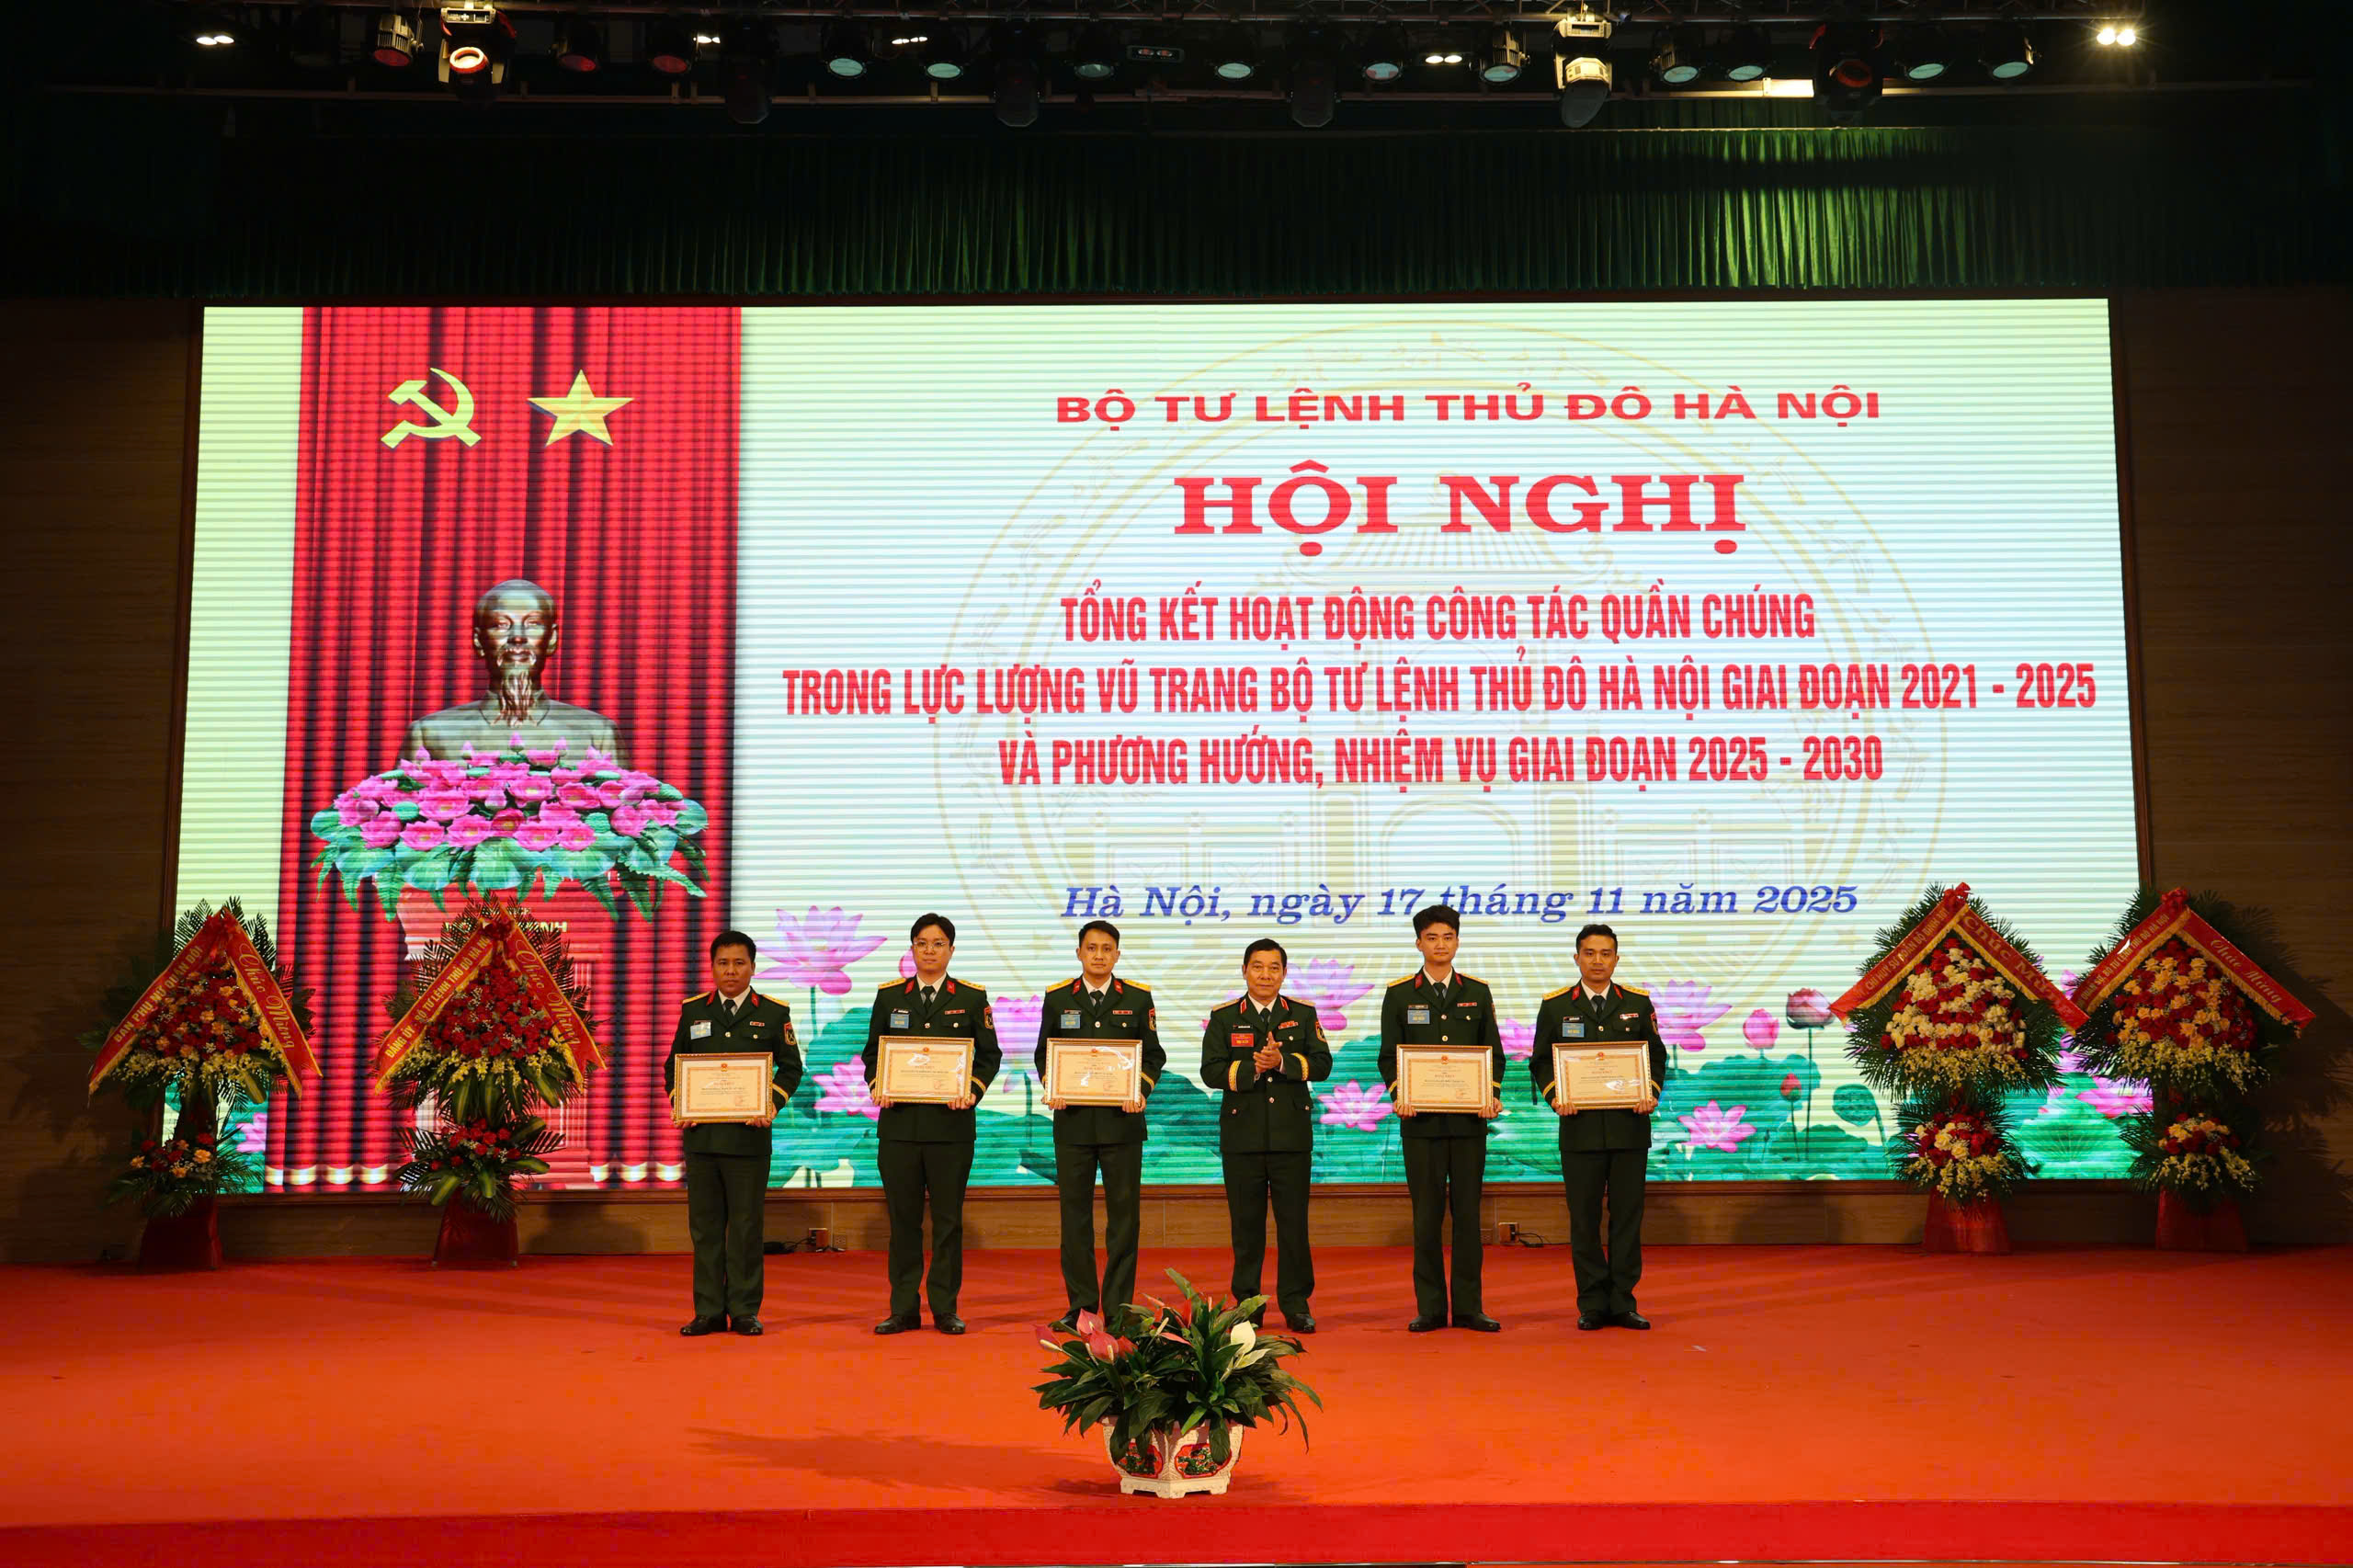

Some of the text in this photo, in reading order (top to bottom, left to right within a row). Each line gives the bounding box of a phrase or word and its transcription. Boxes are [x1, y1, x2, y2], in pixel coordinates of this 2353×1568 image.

[1057, 381, 1880, 431] BỘ TƯ LỆNH THỦ ĐÔ HÀ NỘI
[1174, 459, 1746, 557] HỘI NGHỊ
[1061, 577, 1815, 652] TỔNG KẾT HOẠT ĐỘNG CÔNG TÁC QUẦN CHÚNG
[782, 645, 2097, 724] TRONG LỰC LƯỢNG VŨ TRANG BỘ TƯ LỆNH THỦ ĐÔ HÀ NỘI GIAI ĐOẠN 2021 - 2025
[998, 723, 1883, 793] VÀ PHƯƠNG HƯỚNG, NHIỆM VỤ GIAI ĐOẠN 2025 - 2030
[1063, 881, 1859, 926] Hà Nội, ngày 17 tháng 11 năm 2025
[113, 1021, 134, 1043] BAN
[384, 1039, 403, 1059] ĐẢNG
